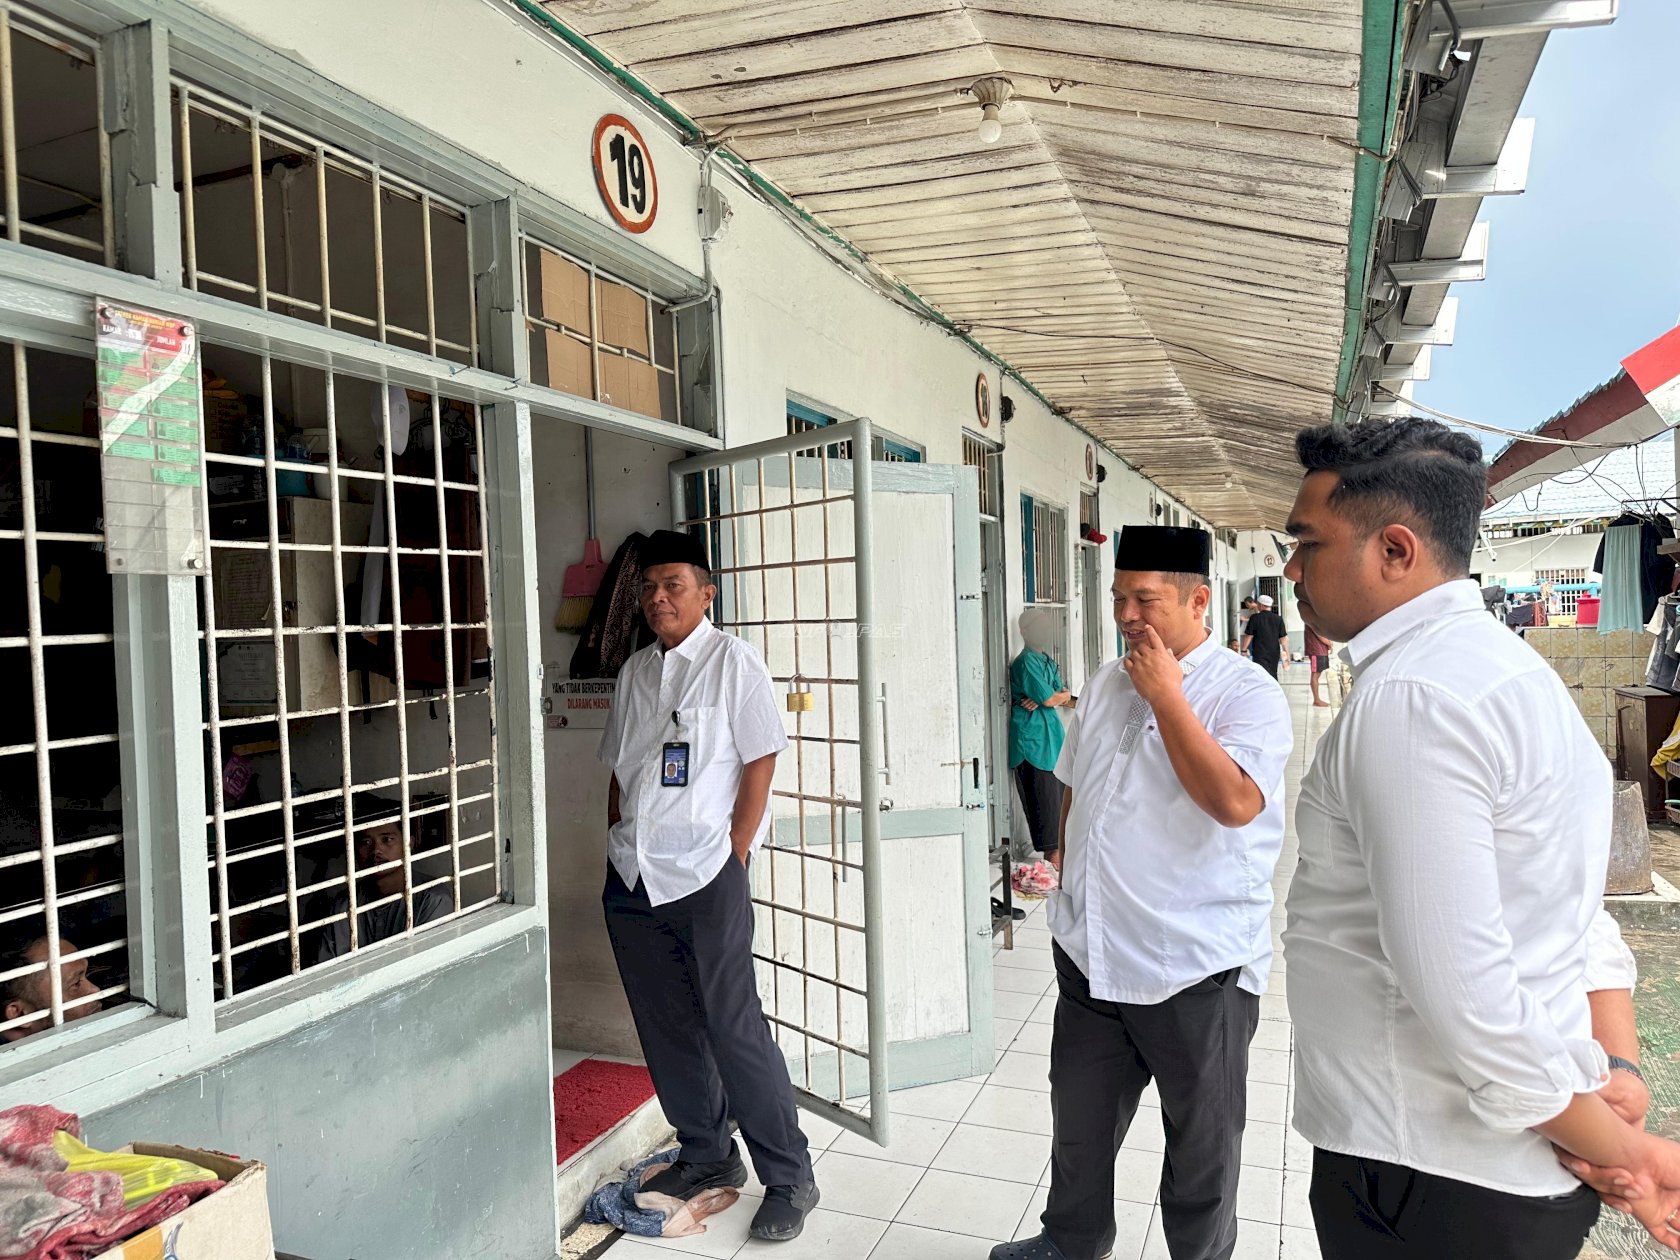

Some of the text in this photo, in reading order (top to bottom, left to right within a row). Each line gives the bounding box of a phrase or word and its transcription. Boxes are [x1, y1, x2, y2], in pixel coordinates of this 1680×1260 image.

[609, 133, 646, 215] 19
[102, 324, 122, 335] KAMAR
[1267, 557, 1273, 565] 12
[551, 682, 616, 694] YANG TIDAK BERKEPENTIN
[567, 698, 610, 710] DILARANG MASUK
